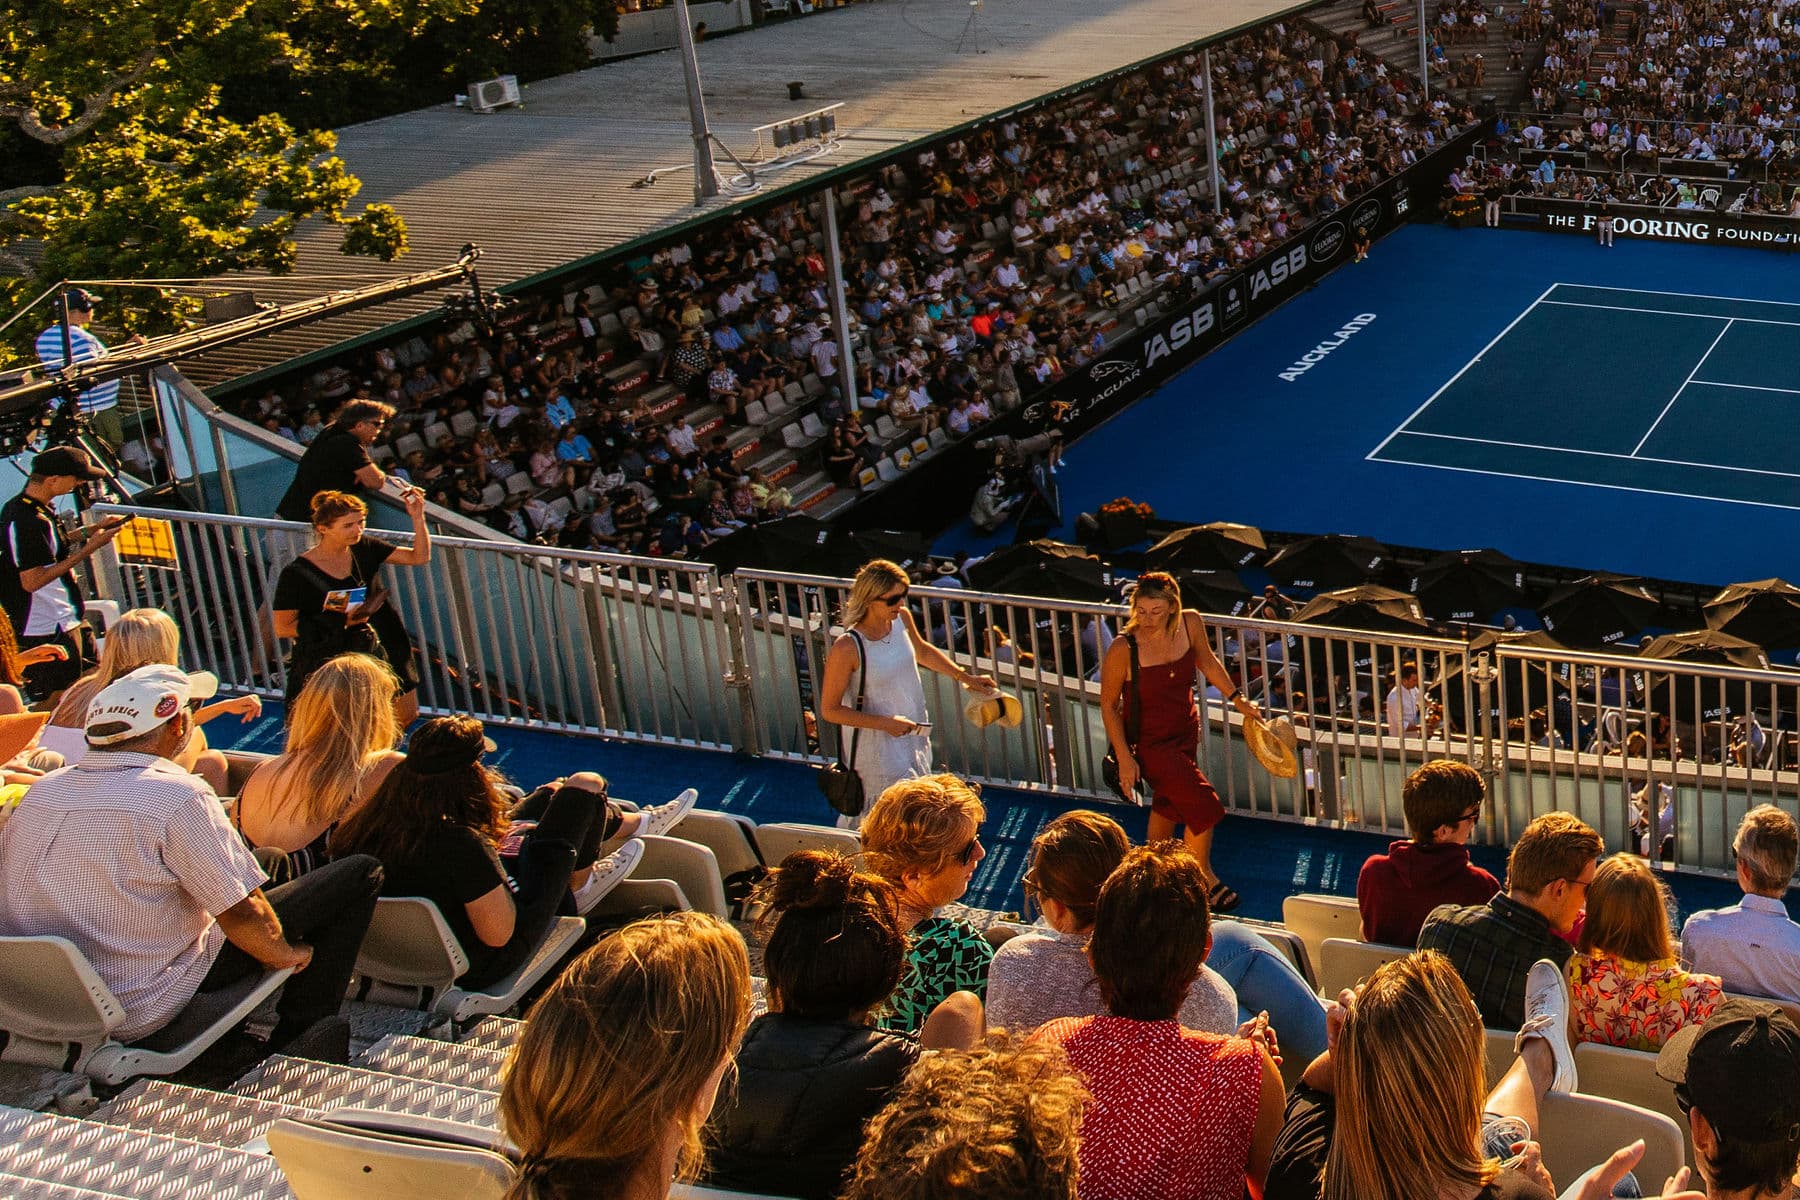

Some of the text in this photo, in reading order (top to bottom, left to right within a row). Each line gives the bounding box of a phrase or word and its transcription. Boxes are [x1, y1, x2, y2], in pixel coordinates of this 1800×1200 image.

[1547, 214, 1575, 227] THE
[1583, 215, 1709, 240] FOORING
[1250, 244, 1308, 300] ASB
[1144, 303, 1214, 368] ASB
[1278, 313, 1376, 381] AUCKLAND
[1087, 368, 1140, 409] JAGUAR
[1354, 658, 1373, 667] AS
[107, 705, 140, 718] AFRICA
